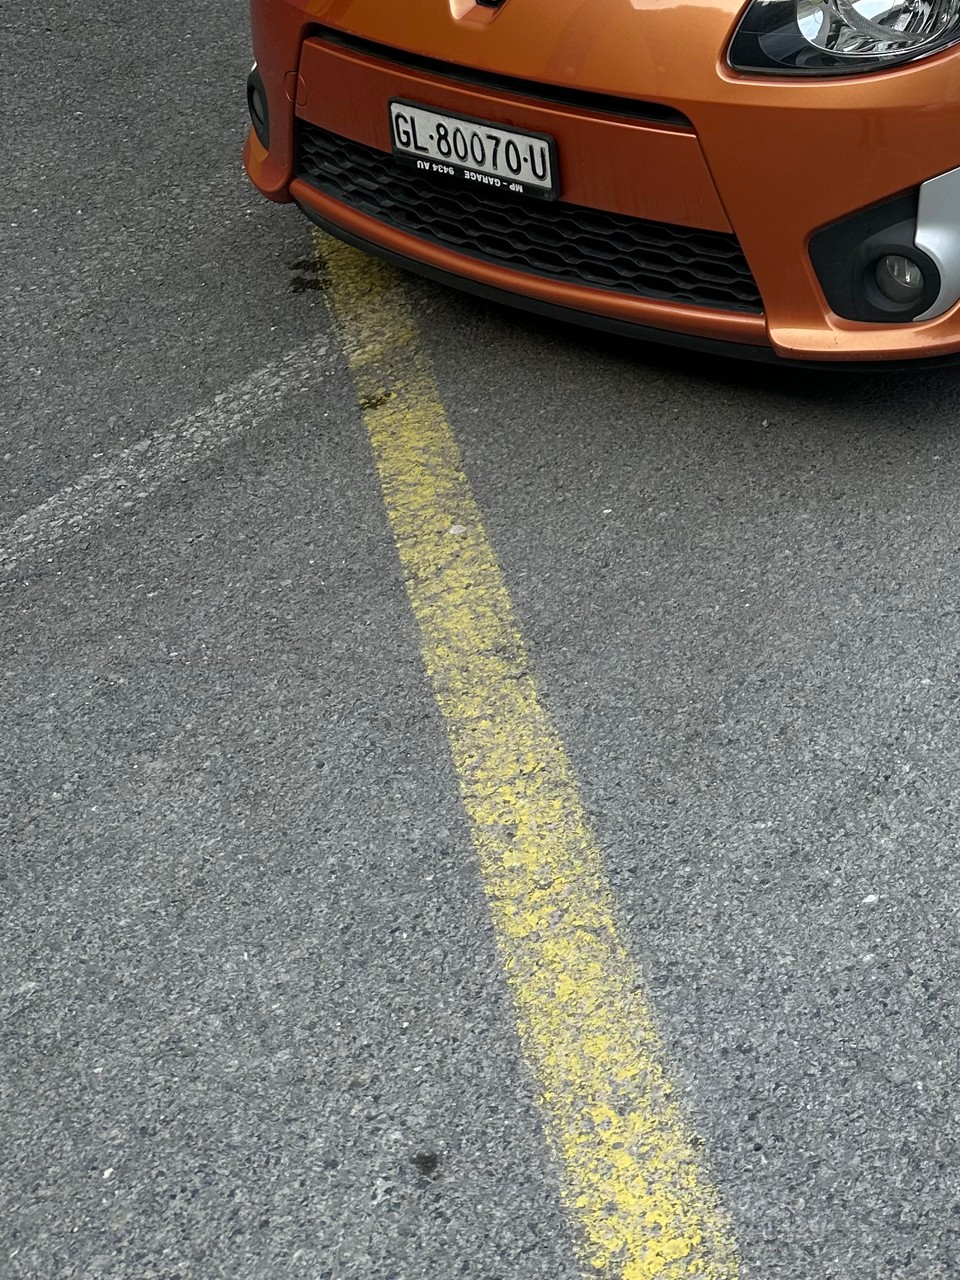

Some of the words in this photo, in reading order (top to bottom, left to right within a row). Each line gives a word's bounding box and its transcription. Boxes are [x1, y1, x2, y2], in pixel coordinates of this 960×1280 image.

[416, 160, 430, 171] AU
[432, 163, 455, 176] 9434
[464, 170, 501, 187] GARAGE
[509, 183, 523, 193] MP
